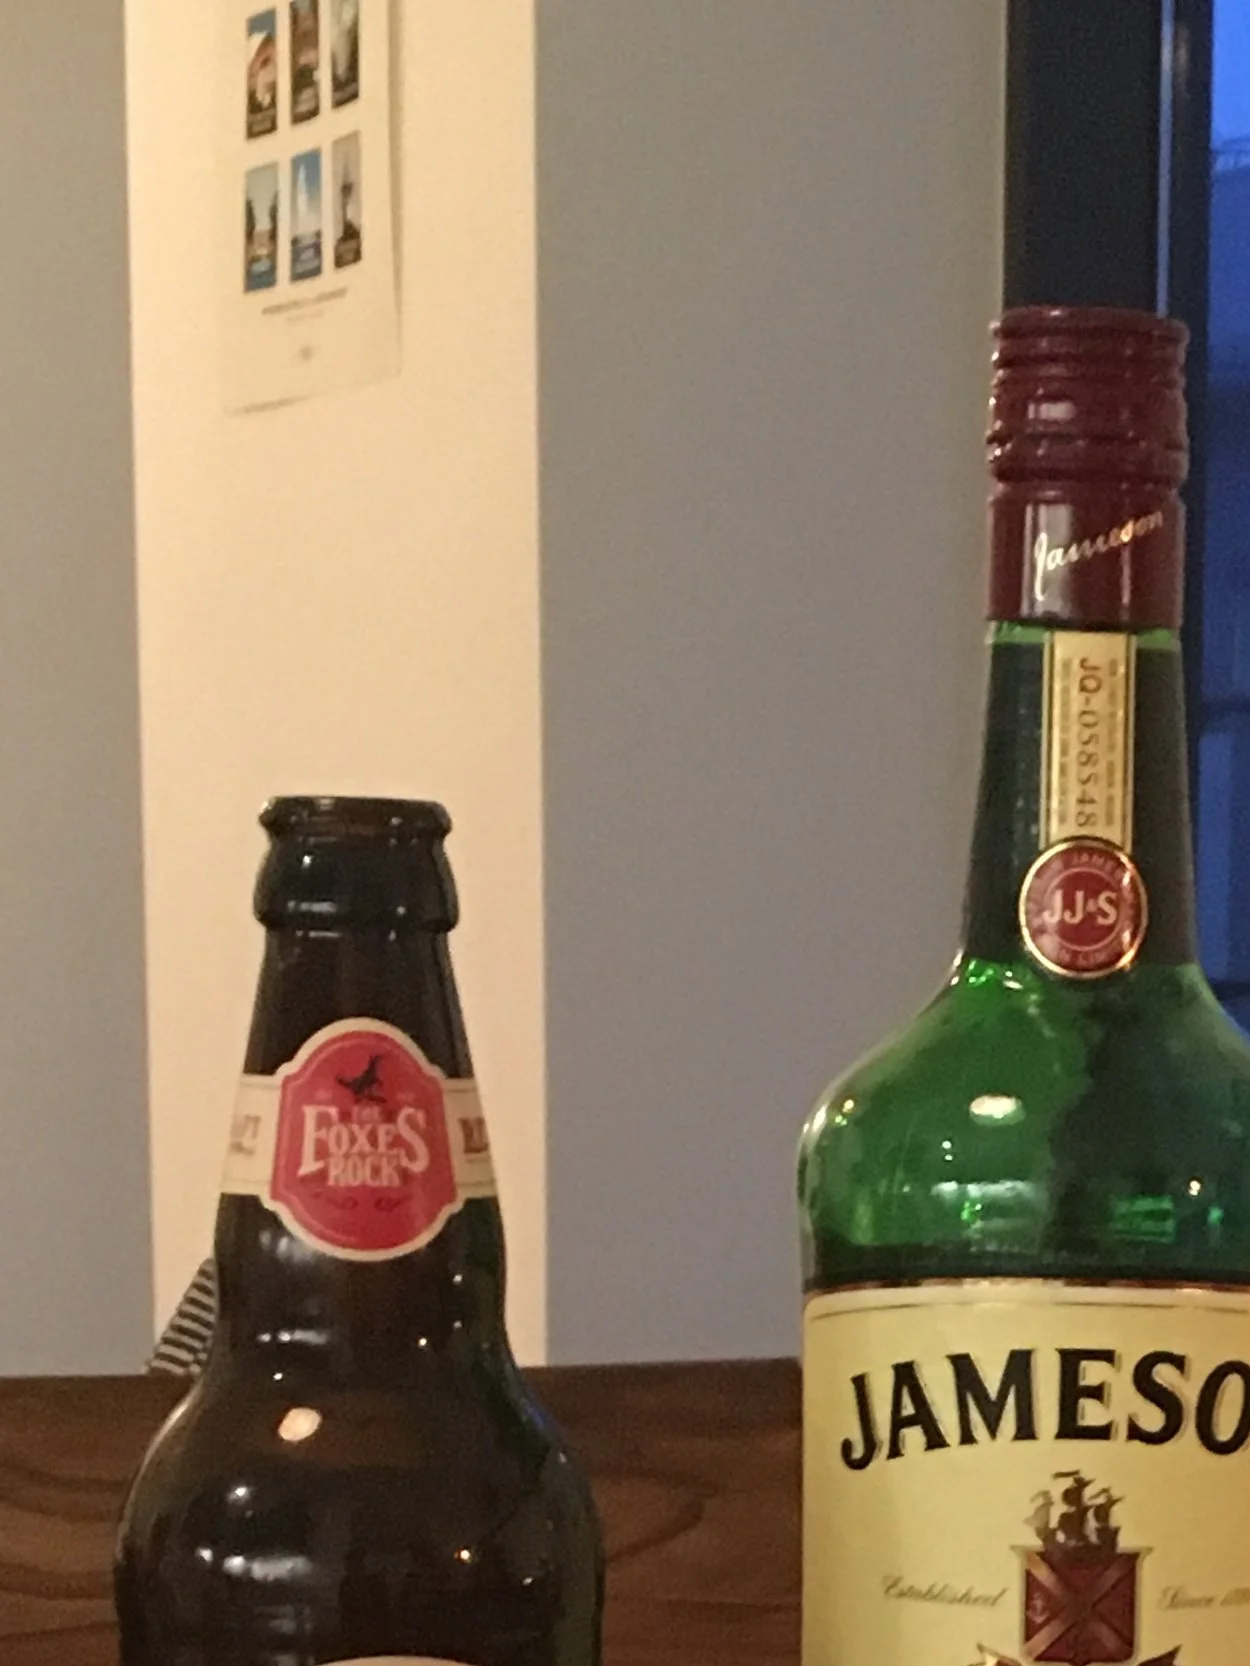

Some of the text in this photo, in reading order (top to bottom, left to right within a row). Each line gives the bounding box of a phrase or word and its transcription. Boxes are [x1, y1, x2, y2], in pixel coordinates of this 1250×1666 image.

[1033, 510, 1164, 601] Jameson
[1075, 656, 1102, 828] JQ-058548
[297, 1104, 430, 1176] FOXES
[326, 1154, 401, 1187] ROCK
